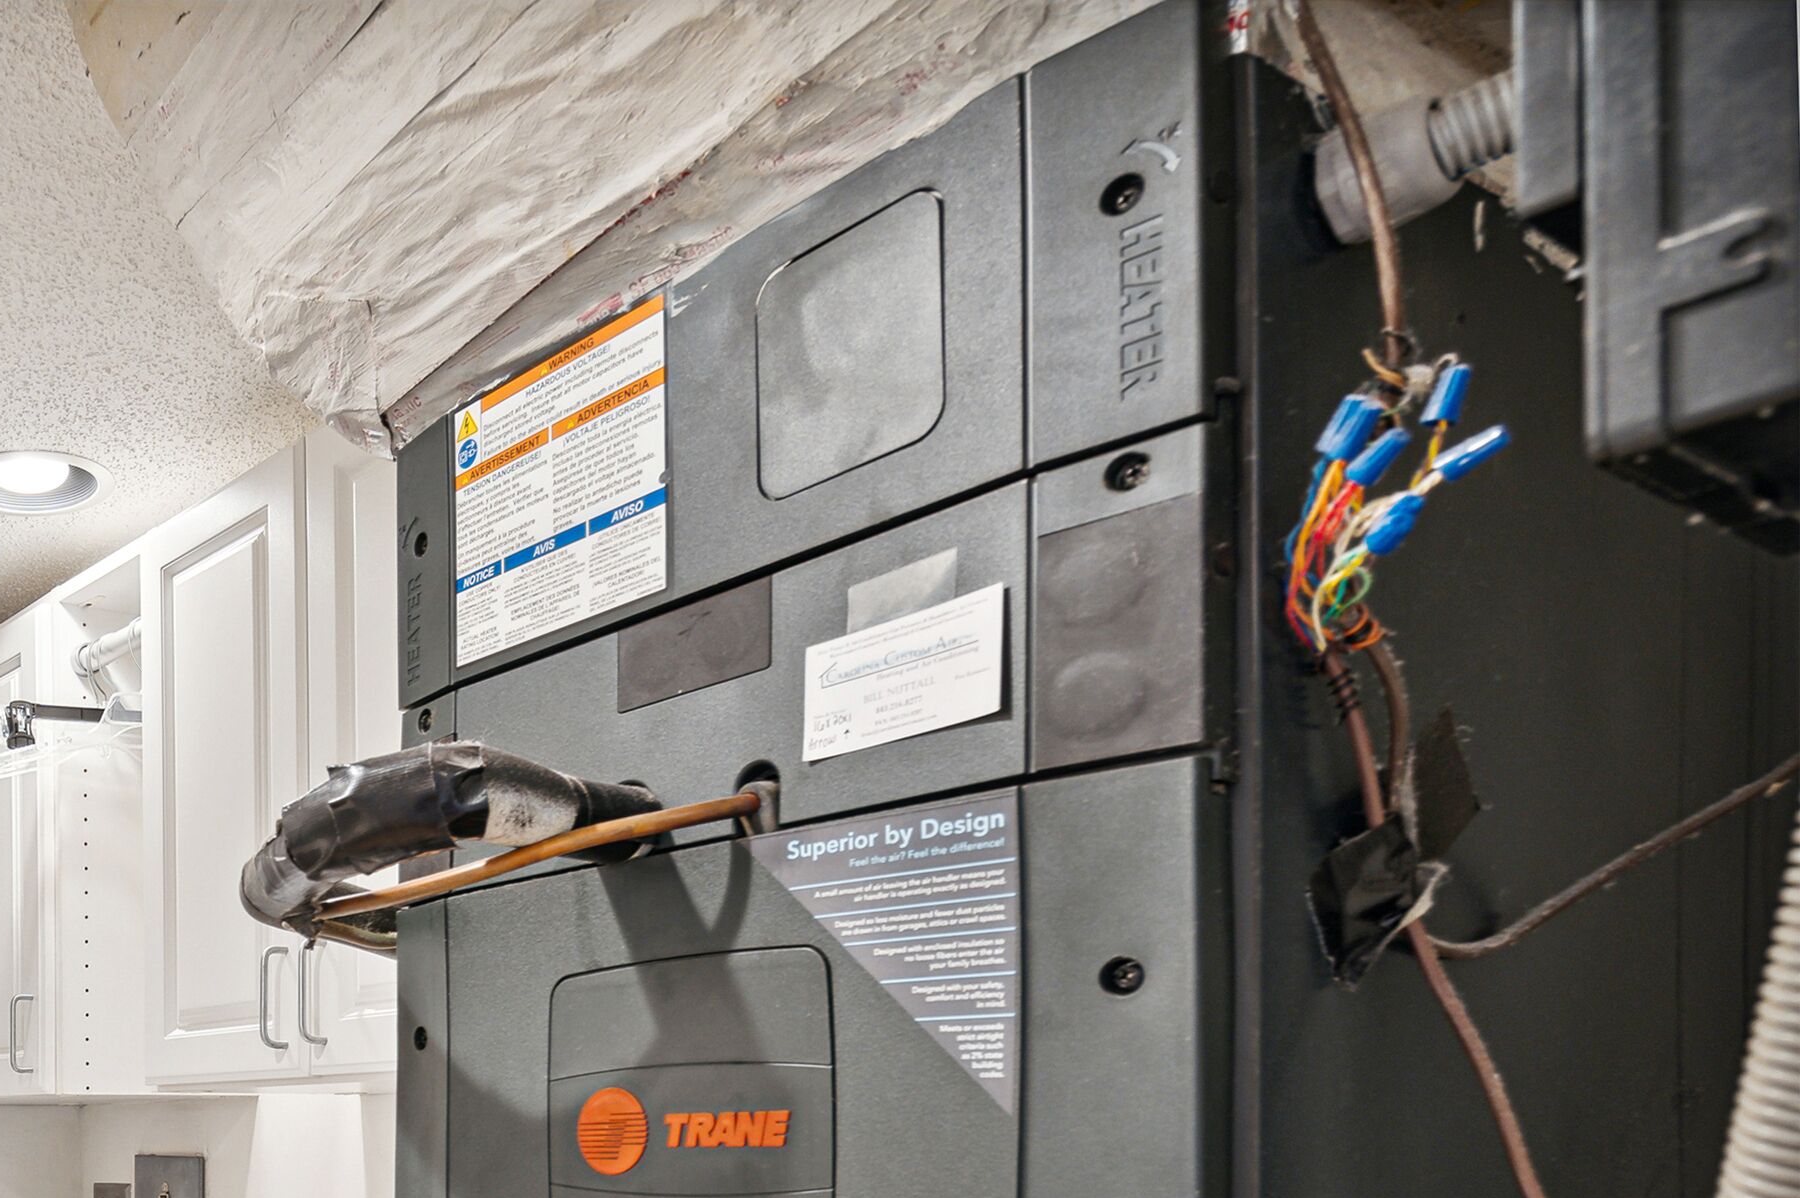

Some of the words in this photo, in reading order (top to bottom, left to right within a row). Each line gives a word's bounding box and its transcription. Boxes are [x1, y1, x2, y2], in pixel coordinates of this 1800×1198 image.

[1119, 213, 1164, 402] HEATER
[525, 365, 570, 397] HAZARDOUS
[572, 343, 610, 371] VOLTAGE!
[548, 337, 593, 370] WARNING
[483, 409, 513, 431] Disconnect
[523, 394, 543, 409] electric
[545, 383, 562, 398] power
[564, 367, 592, 386] including
[594, 353, 616, 369] remote
[618, 330, 658, 356] disconnects
[483, 426, 500, 438] before
[531, 399, 548, 412] Insure
[550, 390, 562, 401] that
[572, 376, 590, 389] motor
[592, 357, 625, 378] capacitors
[627, 347, 643, 360] have
[577, 378, 648, 423] ADVERTENCIA
[483, 426, 513, 447] discharged
[515, 416, 532, 430] stored
[484, 444, 501, 457] Failure
[517, 431, 526, 439] the
[528, 421, 545, 433] above
[546, 410, 562, 423] could
[563, 400, 580, 414] result
[589, 386, 607, 400] death
[616, 370, 640, 386] serious
[563, 420, 598, 446] ¡VOLTAJE
[600, 394, 650, 426] PELIGROSO!
[470, 435, 540, 480] AVERTISSEMENT
[552, 455, 573, 469] incluso
[584, 427, 630, 453] desconexiones
[632, 413, 657, 430] remotas
[552, 439, 585, 460] Desconecte
[587, 432, 600, 442] toda
[593, 457, 604, 468] que
[606, 448, 623, 460] todos
[625, 442, 634, 451] los
[463, 476, 490, 496] TENSION
[492, 450, 541, 482] DANGEREUSE!
[552, 475, 586, 494] capacitores
[587, 469, 596, 478] del
[598, 461, 616, 473] motor
[617, 451, 636, 464] hayan
[552, 484, 586, 503] descargado
[594, 471, 614, 484] voltaje
[611, 499, 643, 523] AVISO
[532, 538, 555, 557] AVIS
[463, 565, 494, 588] NOTICE
[407, 572, 423, 687] HEATER
[787, 830, 878, 861] Superior
[885, 823, 913, 847] by
[920, 811, 1004, 840] Design
[849, 856, 869, 867] Feel
[871, 854, 886, 864] the
[888, 851, 904, 862] air?
[907, 847, 928, 859] Feel
[930, 846, 947, 856] the
[949, 836, 1004, 853] difference!
[663, 1109, 792, 1147] TRANE
